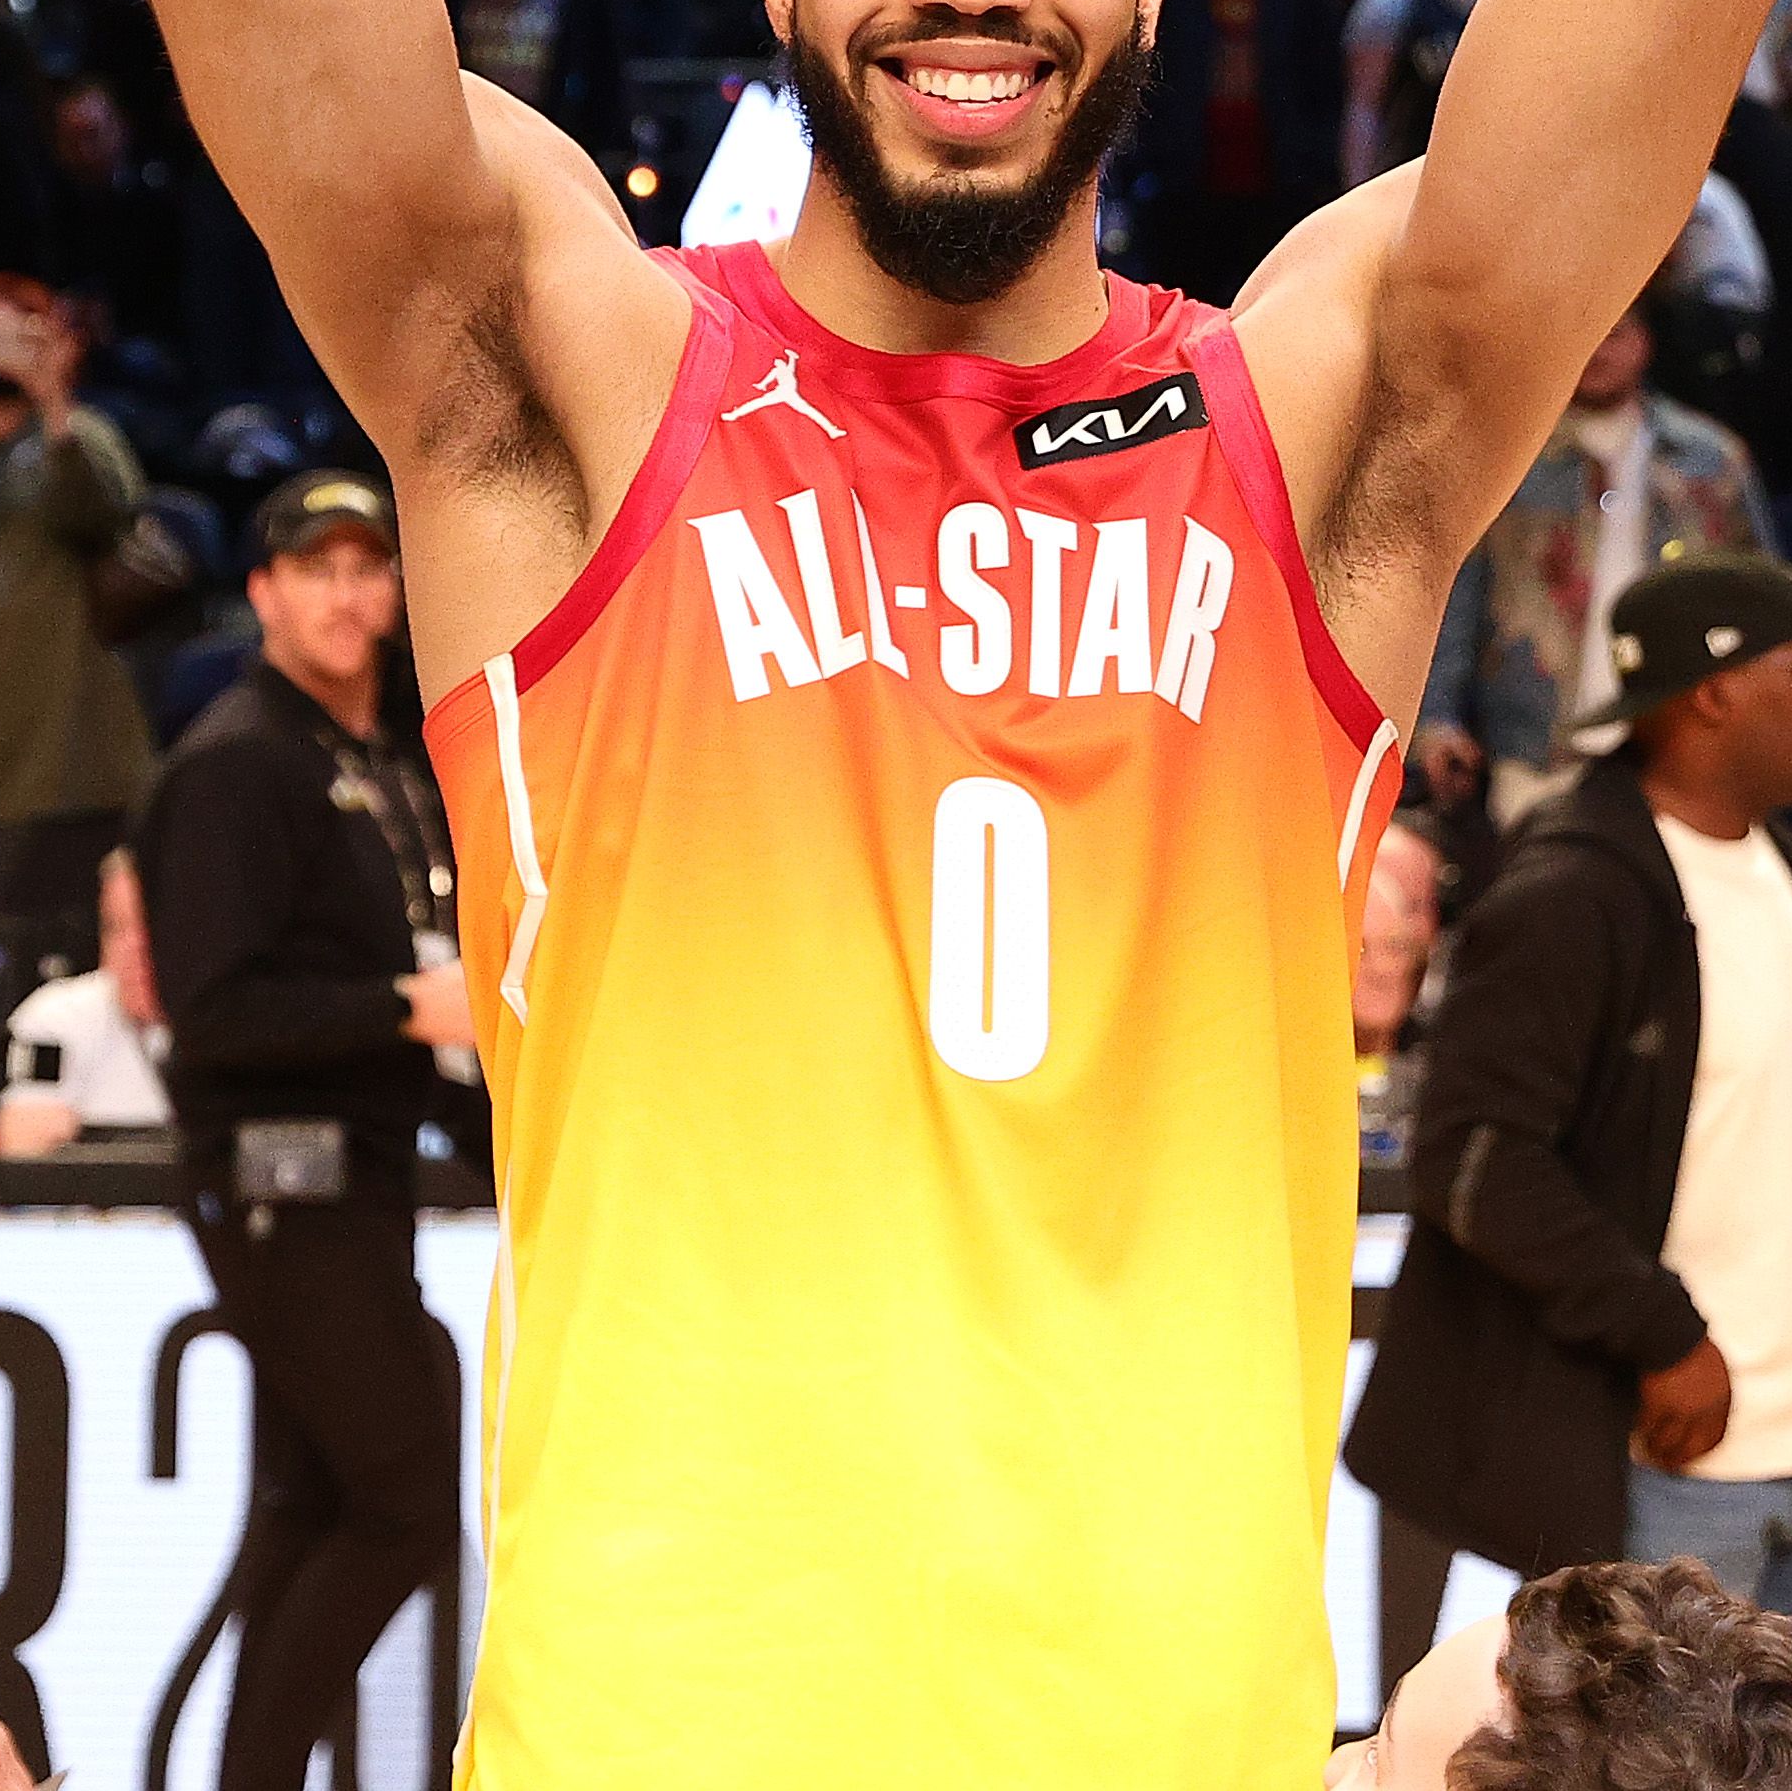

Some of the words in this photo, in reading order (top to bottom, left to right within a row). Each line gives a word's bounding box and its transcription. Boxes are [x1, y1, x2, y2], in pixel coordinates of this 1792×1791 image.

[1031, 383, 1188, 455] KIA
[686, 488, 1234, 725] ALL-STAR
[929, 776, 1049, 1082] 0
